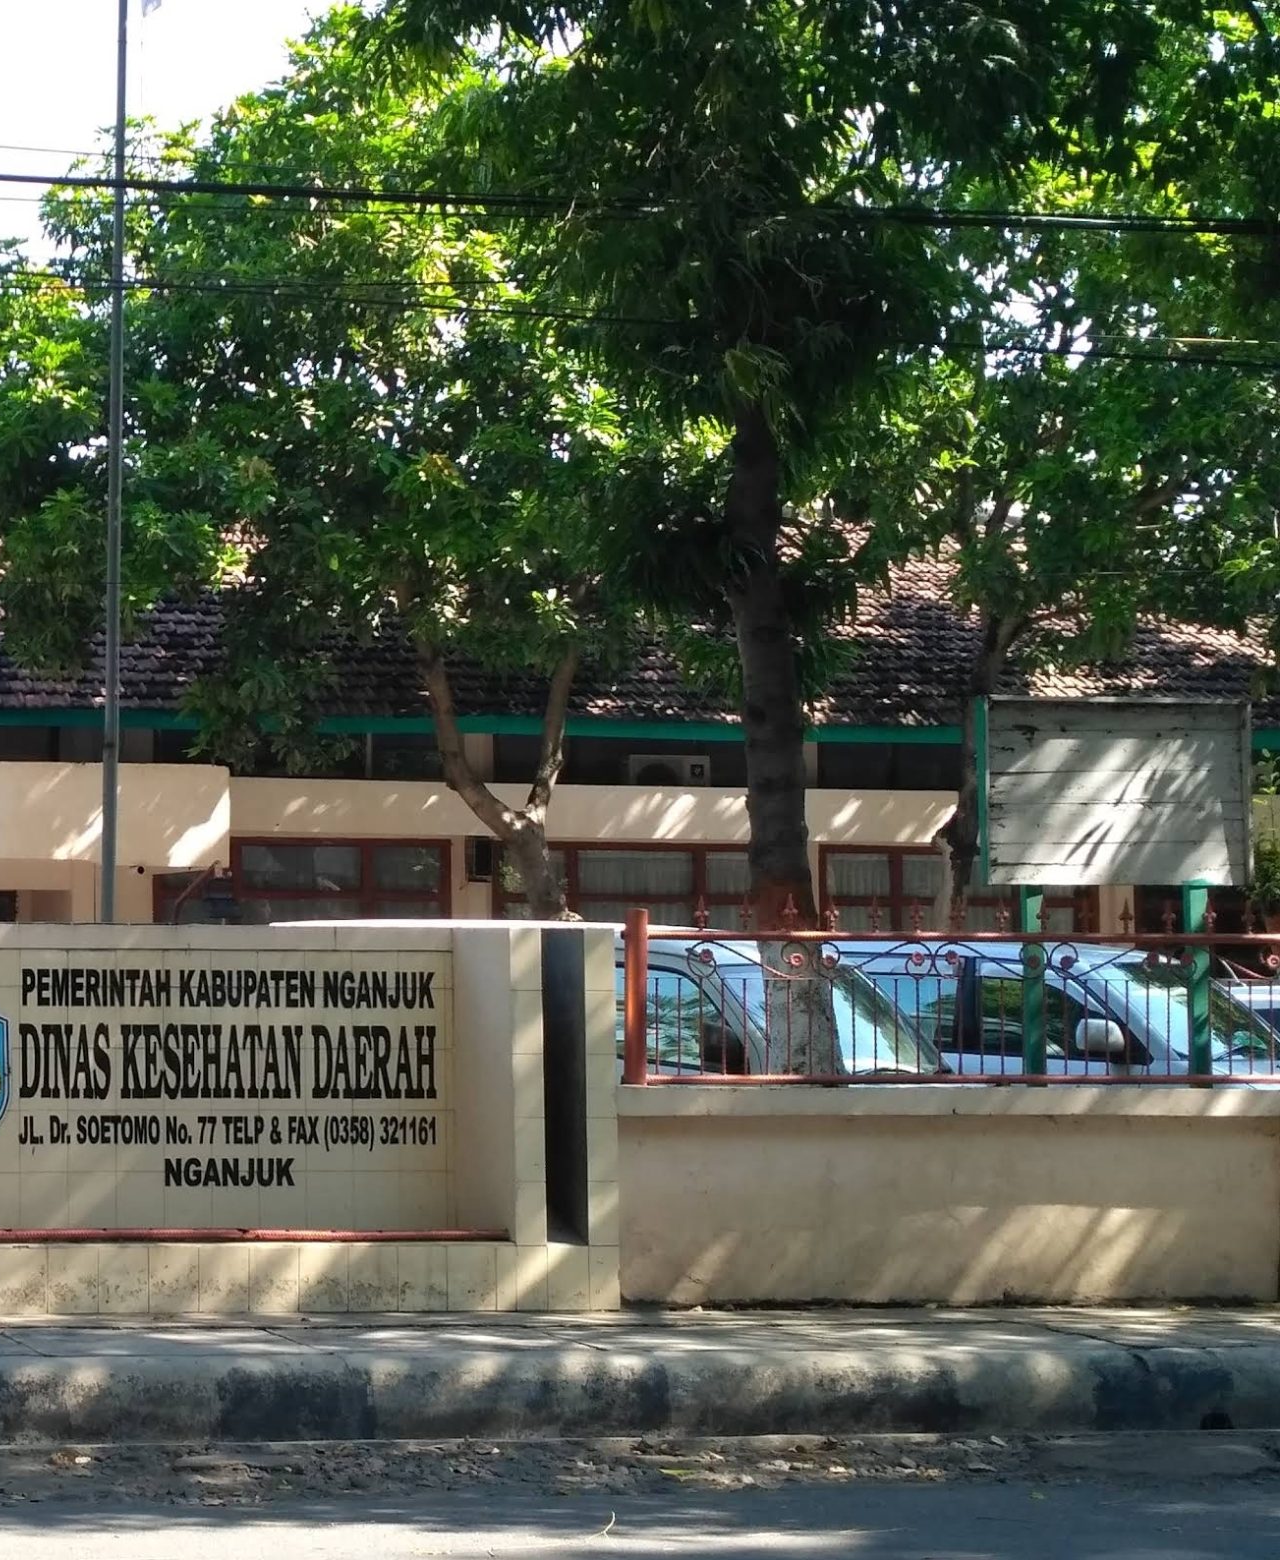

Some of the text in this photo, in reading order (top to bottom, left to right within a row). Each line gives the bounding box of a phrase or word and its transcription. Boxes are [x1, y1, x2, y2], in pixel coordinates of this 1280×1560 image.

[22, 968, 435, 1009] PEMERINTAH KABUPATEN NGANJUK
[19, 1022, 437, 1100] DINAS KESEHATAN DAERAH
[19, 1115, 437, 1151] JL. Dr. SOETOMO No. 77 TELP & FAX (0358) 321161
[164, 1158, 295, 1187] NGANJUK
